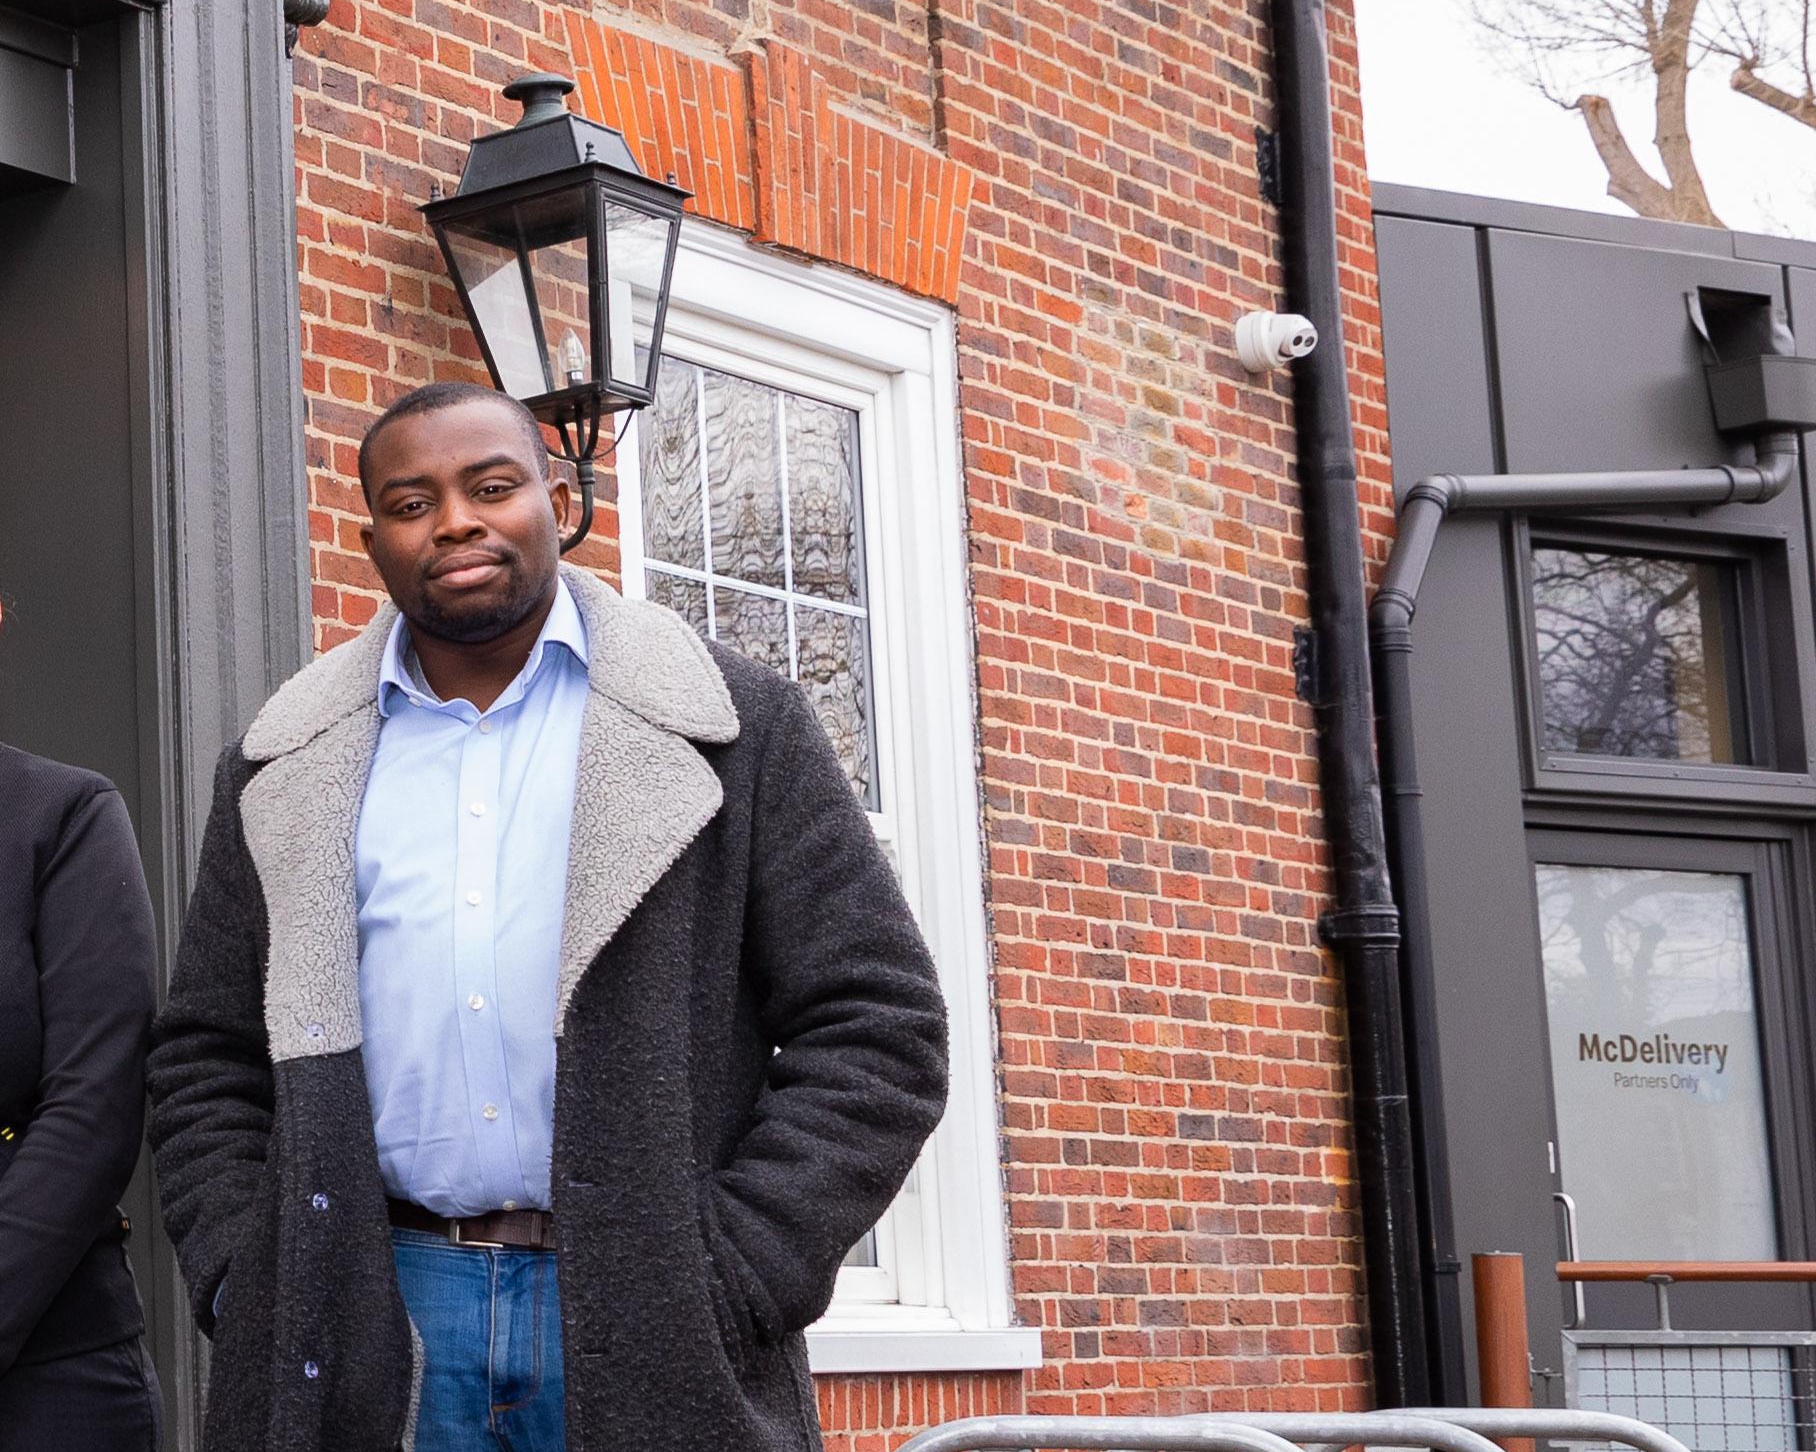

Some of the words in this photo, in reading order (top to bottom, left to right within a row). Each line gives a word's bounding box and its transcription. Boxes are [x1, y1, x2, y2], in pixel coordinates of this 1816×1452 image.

[1578, 1032, 1728, 1075] McDelivery
[1614, 1072, 1669, 1089] Partners
[1670, 1073, 1700, 1093] Only
